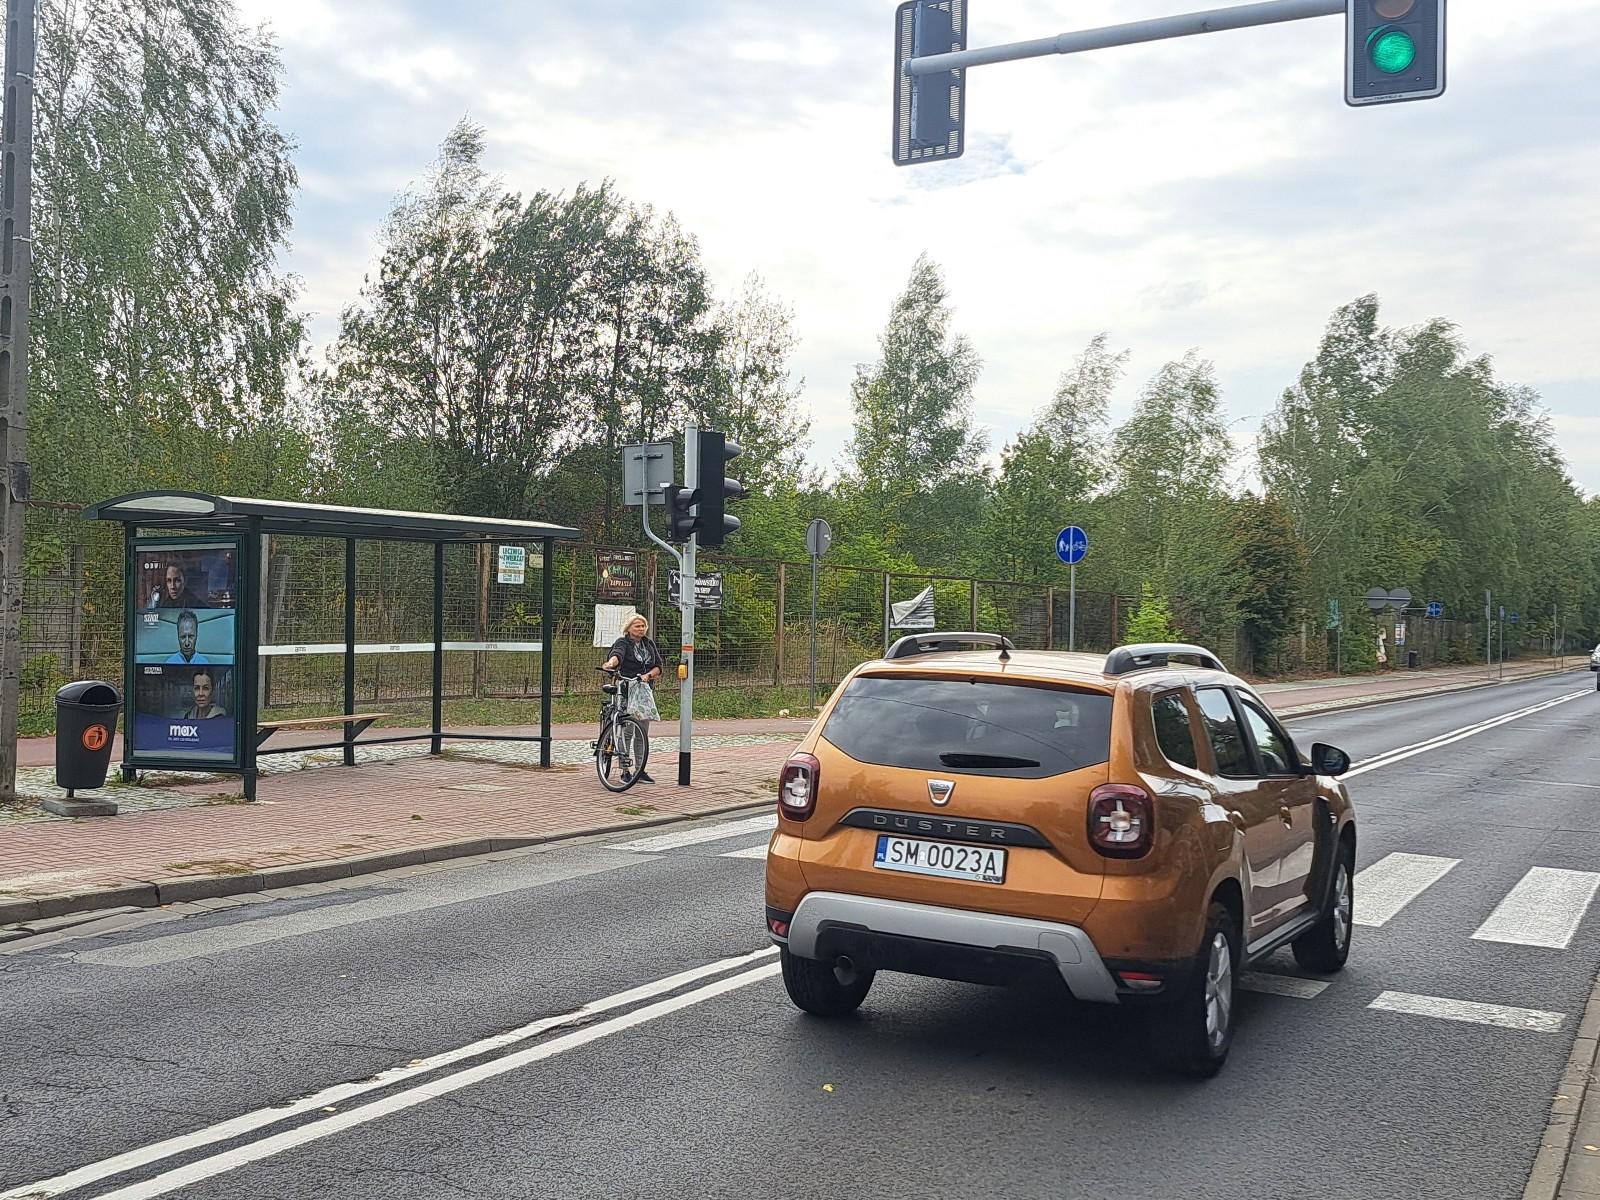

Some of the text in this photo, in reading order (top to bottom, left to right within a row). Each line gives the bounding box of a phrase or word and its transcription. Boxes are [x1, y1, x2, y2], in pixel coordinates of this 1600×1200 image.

[169, 725, 198, 737] max
[872, 814, 1006, 839] DUSTER
[877, 852, 886, 863] PL
[890, 840, 997, 876] SM 0023A
